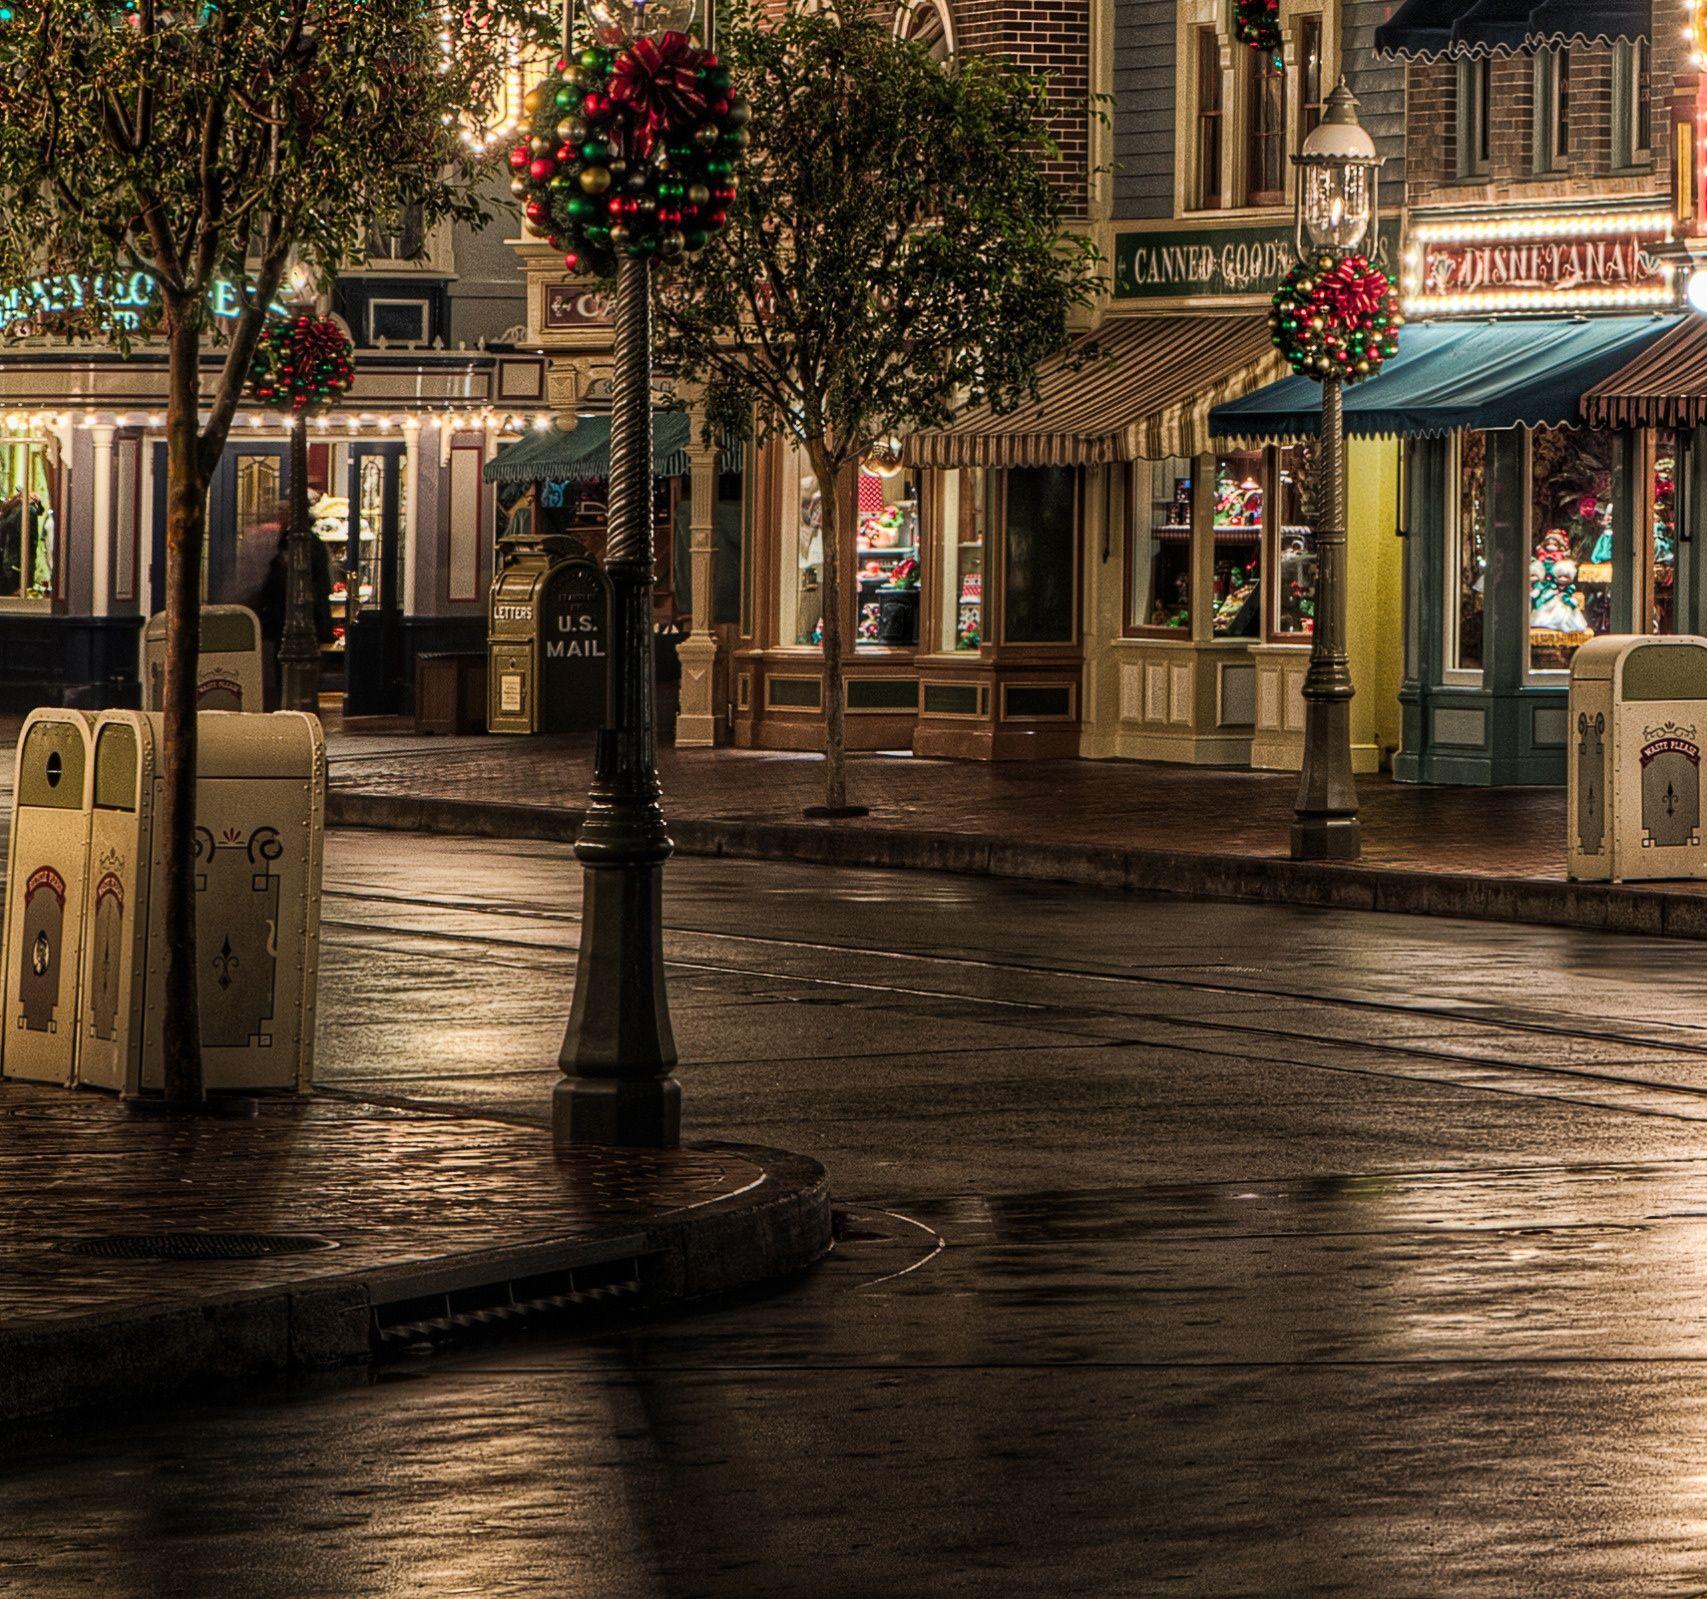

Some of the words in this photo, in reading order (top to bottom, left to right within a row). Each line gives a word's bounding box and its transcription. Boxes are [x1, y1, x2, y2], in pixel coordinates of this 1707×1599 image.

[1134, 245, 1213, 285] CANNED
[1457, 239, 1629, 293] DISNEYANA
[493, 606, 533, 620] LETTERS
[558, 615, 599, 632] U.S.
[546, 640, 606, 658] MAIL
[1644, 740, 1669, 756] WASTE
[1670, 740, 1698, 757] PLEASE
